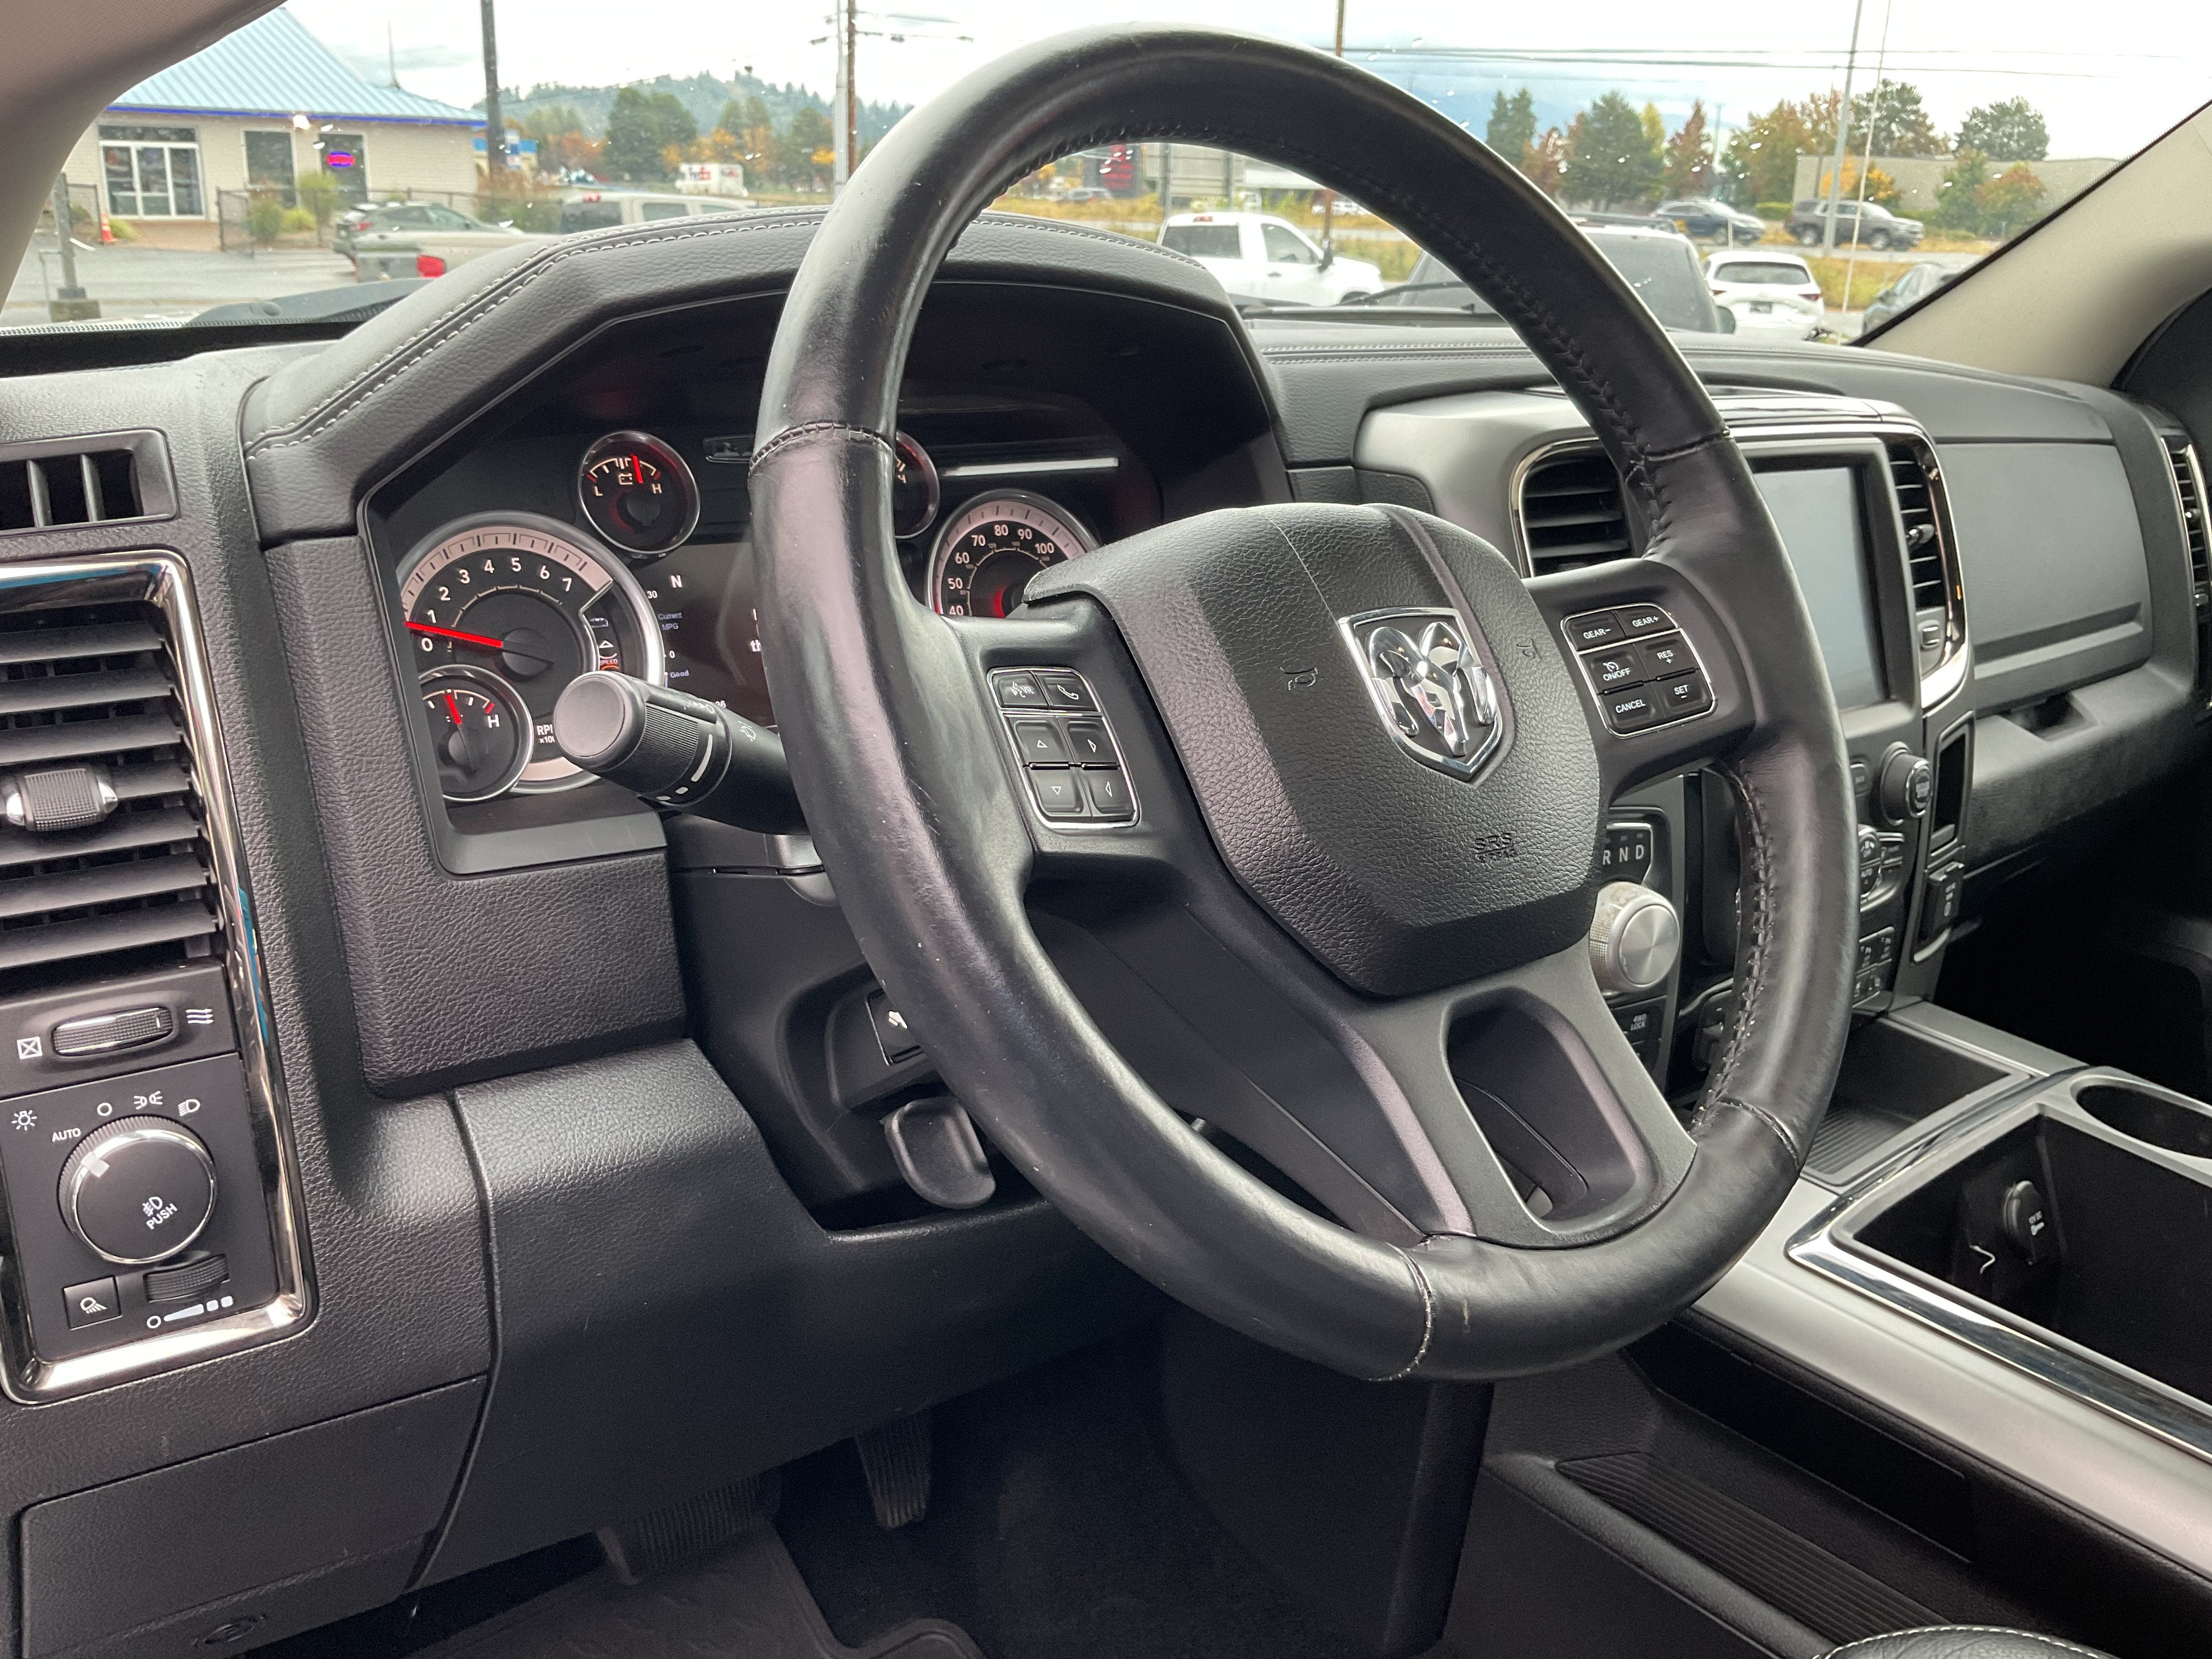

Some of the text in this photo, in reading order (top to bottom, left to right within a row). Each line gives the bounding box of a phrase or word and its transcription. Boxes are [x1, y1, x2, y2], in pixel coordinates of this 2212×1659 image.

[594, 486, 603, 496] L
[652, 483, 662, 494] H
[994, 524, 1008, 537] 80
[1018, 528, 1032, 540] 90
[971, 534, 986, 546] 70
[1035, 543, 1054, 555] 100
[955, 552, 969, 564] 60
[671, 575, 682, 588] N
[947, 578, 963, 589] 50
[647, 590, 658, 599] 30
[421, 557, 572, 652] 0 1 2 3 4 5 6 7
[949, 605, 963, 616] 40
[1632, 616, 1660, 628] GEAR+
[669, 650, 675, 659] 0
[1656, 650, 1673, 660] RES
[670, 669, 690, 678] Good
[1602, 668, 1630, 681] ON/OFF
[1674, 685, 1688, 695] SET
[1615, 699, 1646, 714] CANCEL
[487, 714, 500, 729] H
[537, 724, 553, 736] RP
[1602, 844, 1644, 865] R N D
[52, 1127, 81, 1142] AUTO
[146, 1203, 178, 1229] PUSH
